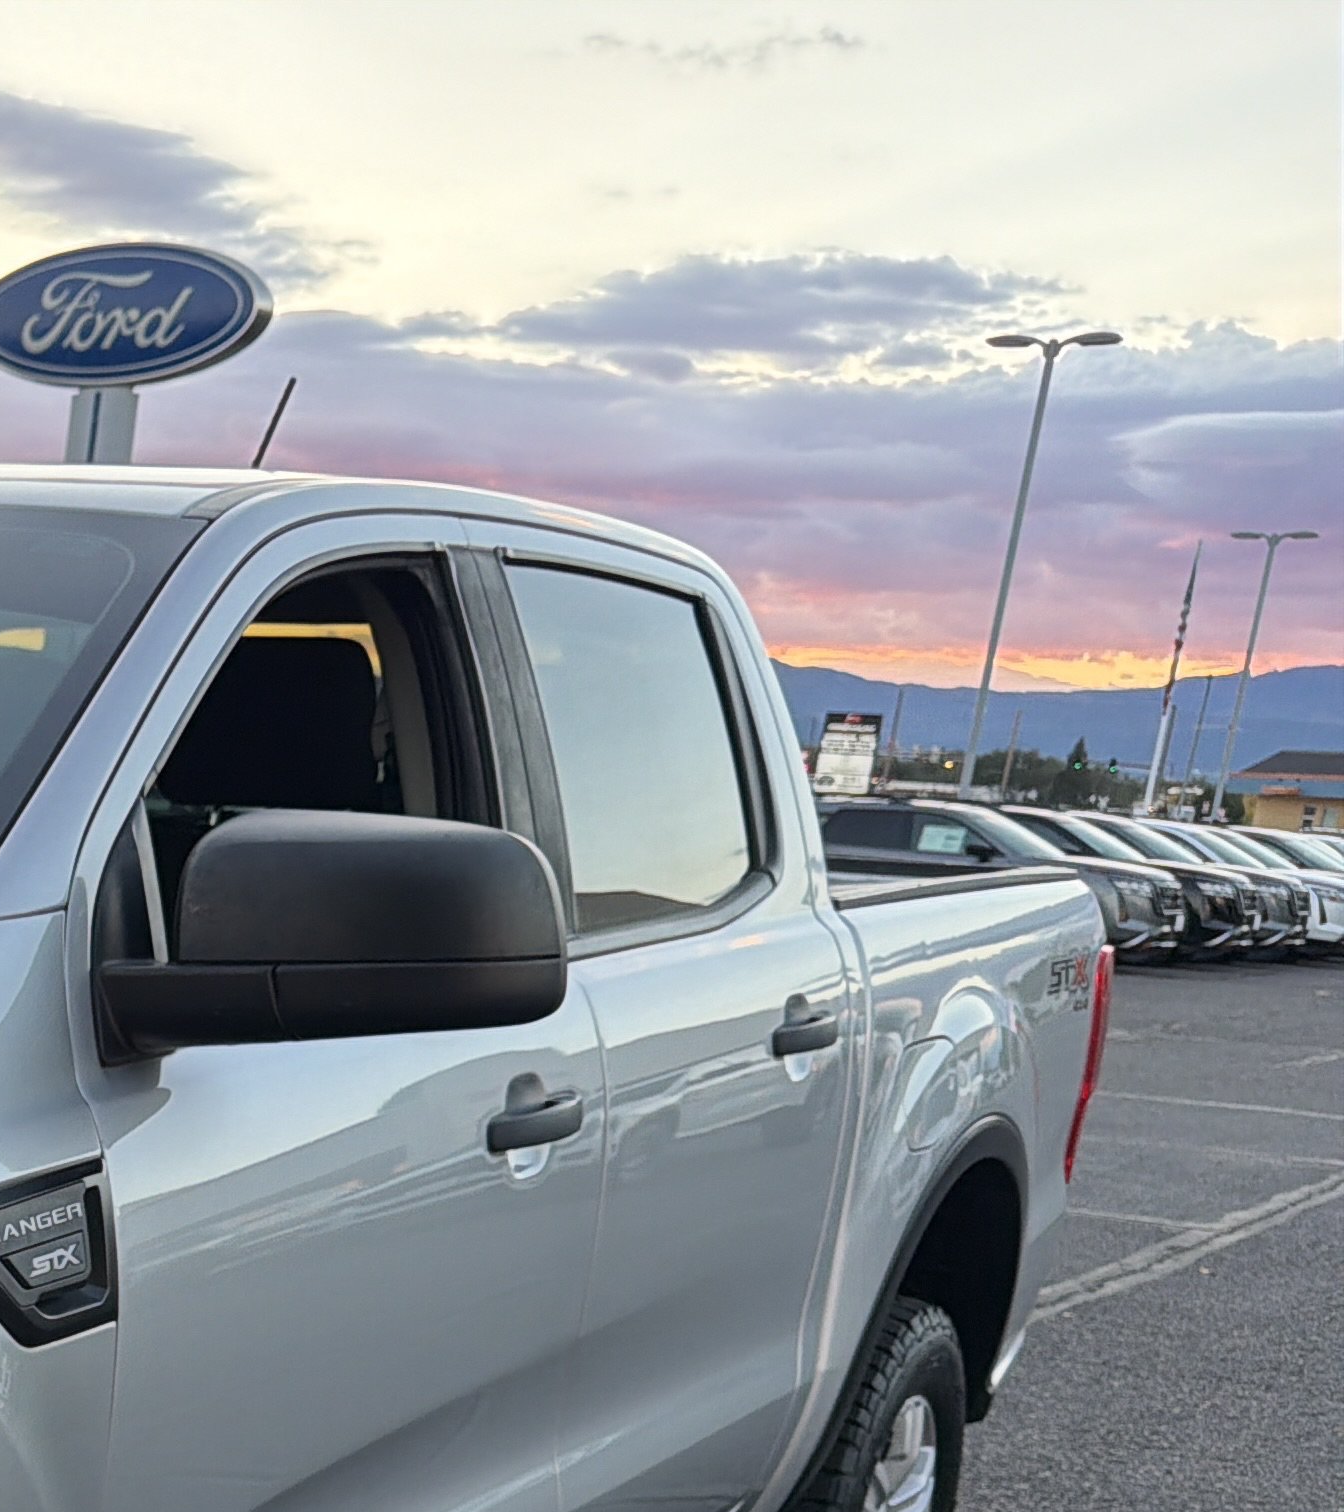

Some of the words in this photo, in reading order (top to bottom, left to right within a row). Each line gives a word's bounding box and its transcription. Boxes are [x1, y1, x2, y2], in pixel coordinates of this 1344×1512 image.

[20, 269, 195, 355] Ford
[1046, 953, 1089, 996] STX
[29, 1243, 81, 1278] STX
